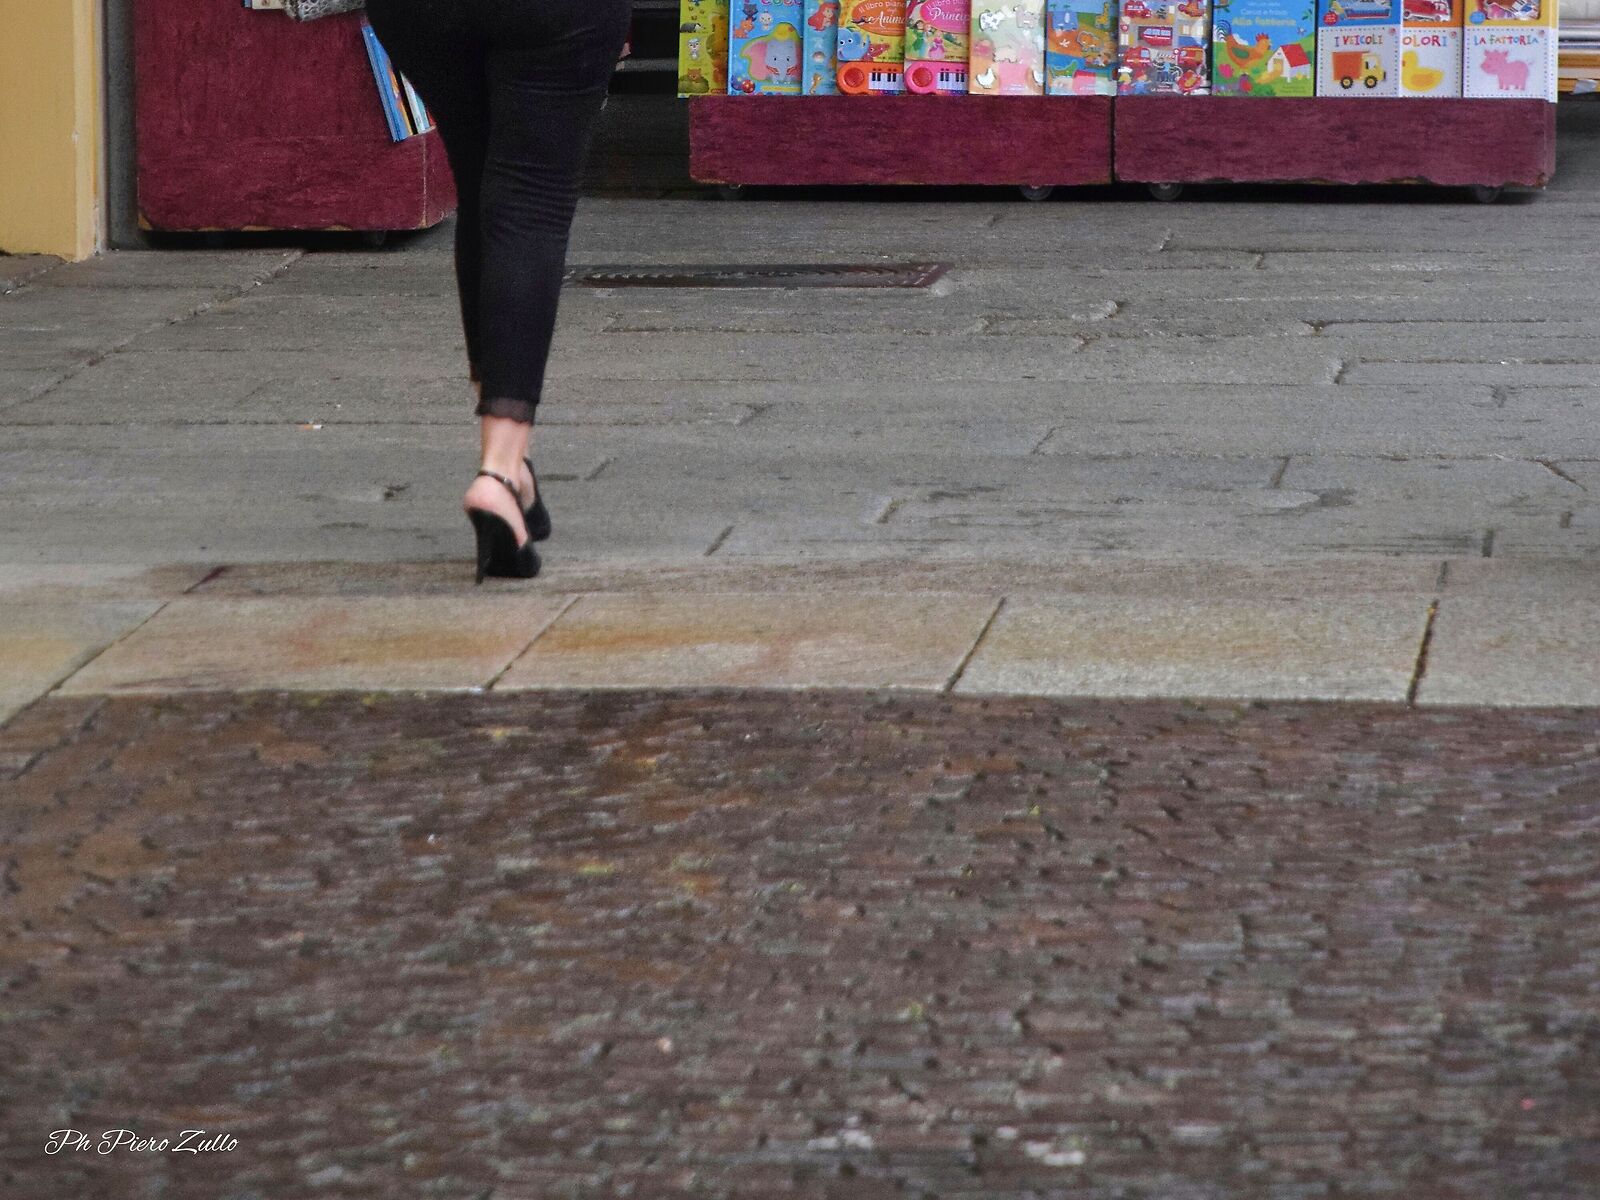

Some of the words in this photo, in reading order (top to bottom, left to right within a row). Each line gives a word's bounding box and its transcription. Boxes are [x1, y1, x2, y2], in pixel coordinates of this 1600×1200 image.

[865, 1, 884, 10] libro
[1333, 36, 1340, 47] I
[1342, 34, 1383, 47] VEICOLI
[1402, 35, 1448, 47] OLORI
[1473, 35, 1486, 46] LA
[1489, 34, 1540, 46] FATTORIA
